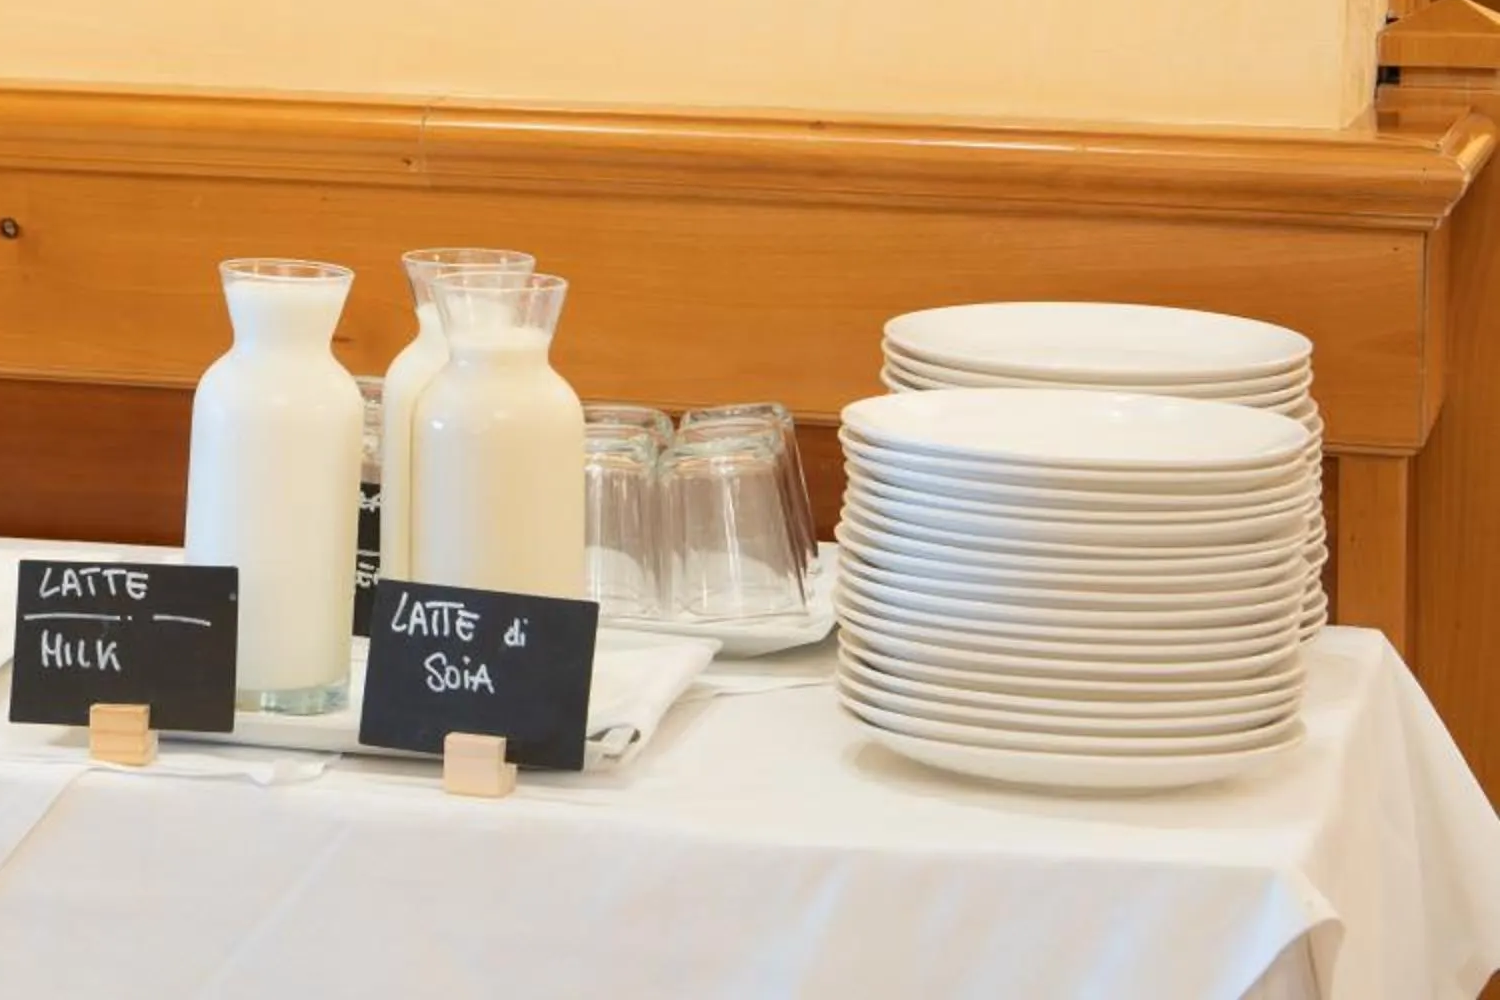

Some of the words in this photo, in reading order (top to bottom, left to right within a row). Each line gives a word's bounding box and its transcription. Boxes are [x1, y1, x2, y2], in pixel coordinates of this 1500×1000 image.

[38, 567, 149, 600] LATTE
[391, 591, 481, 642] LATTE
[503, 618, 529, 648] di
[41, 628, 122, 672] MILK
